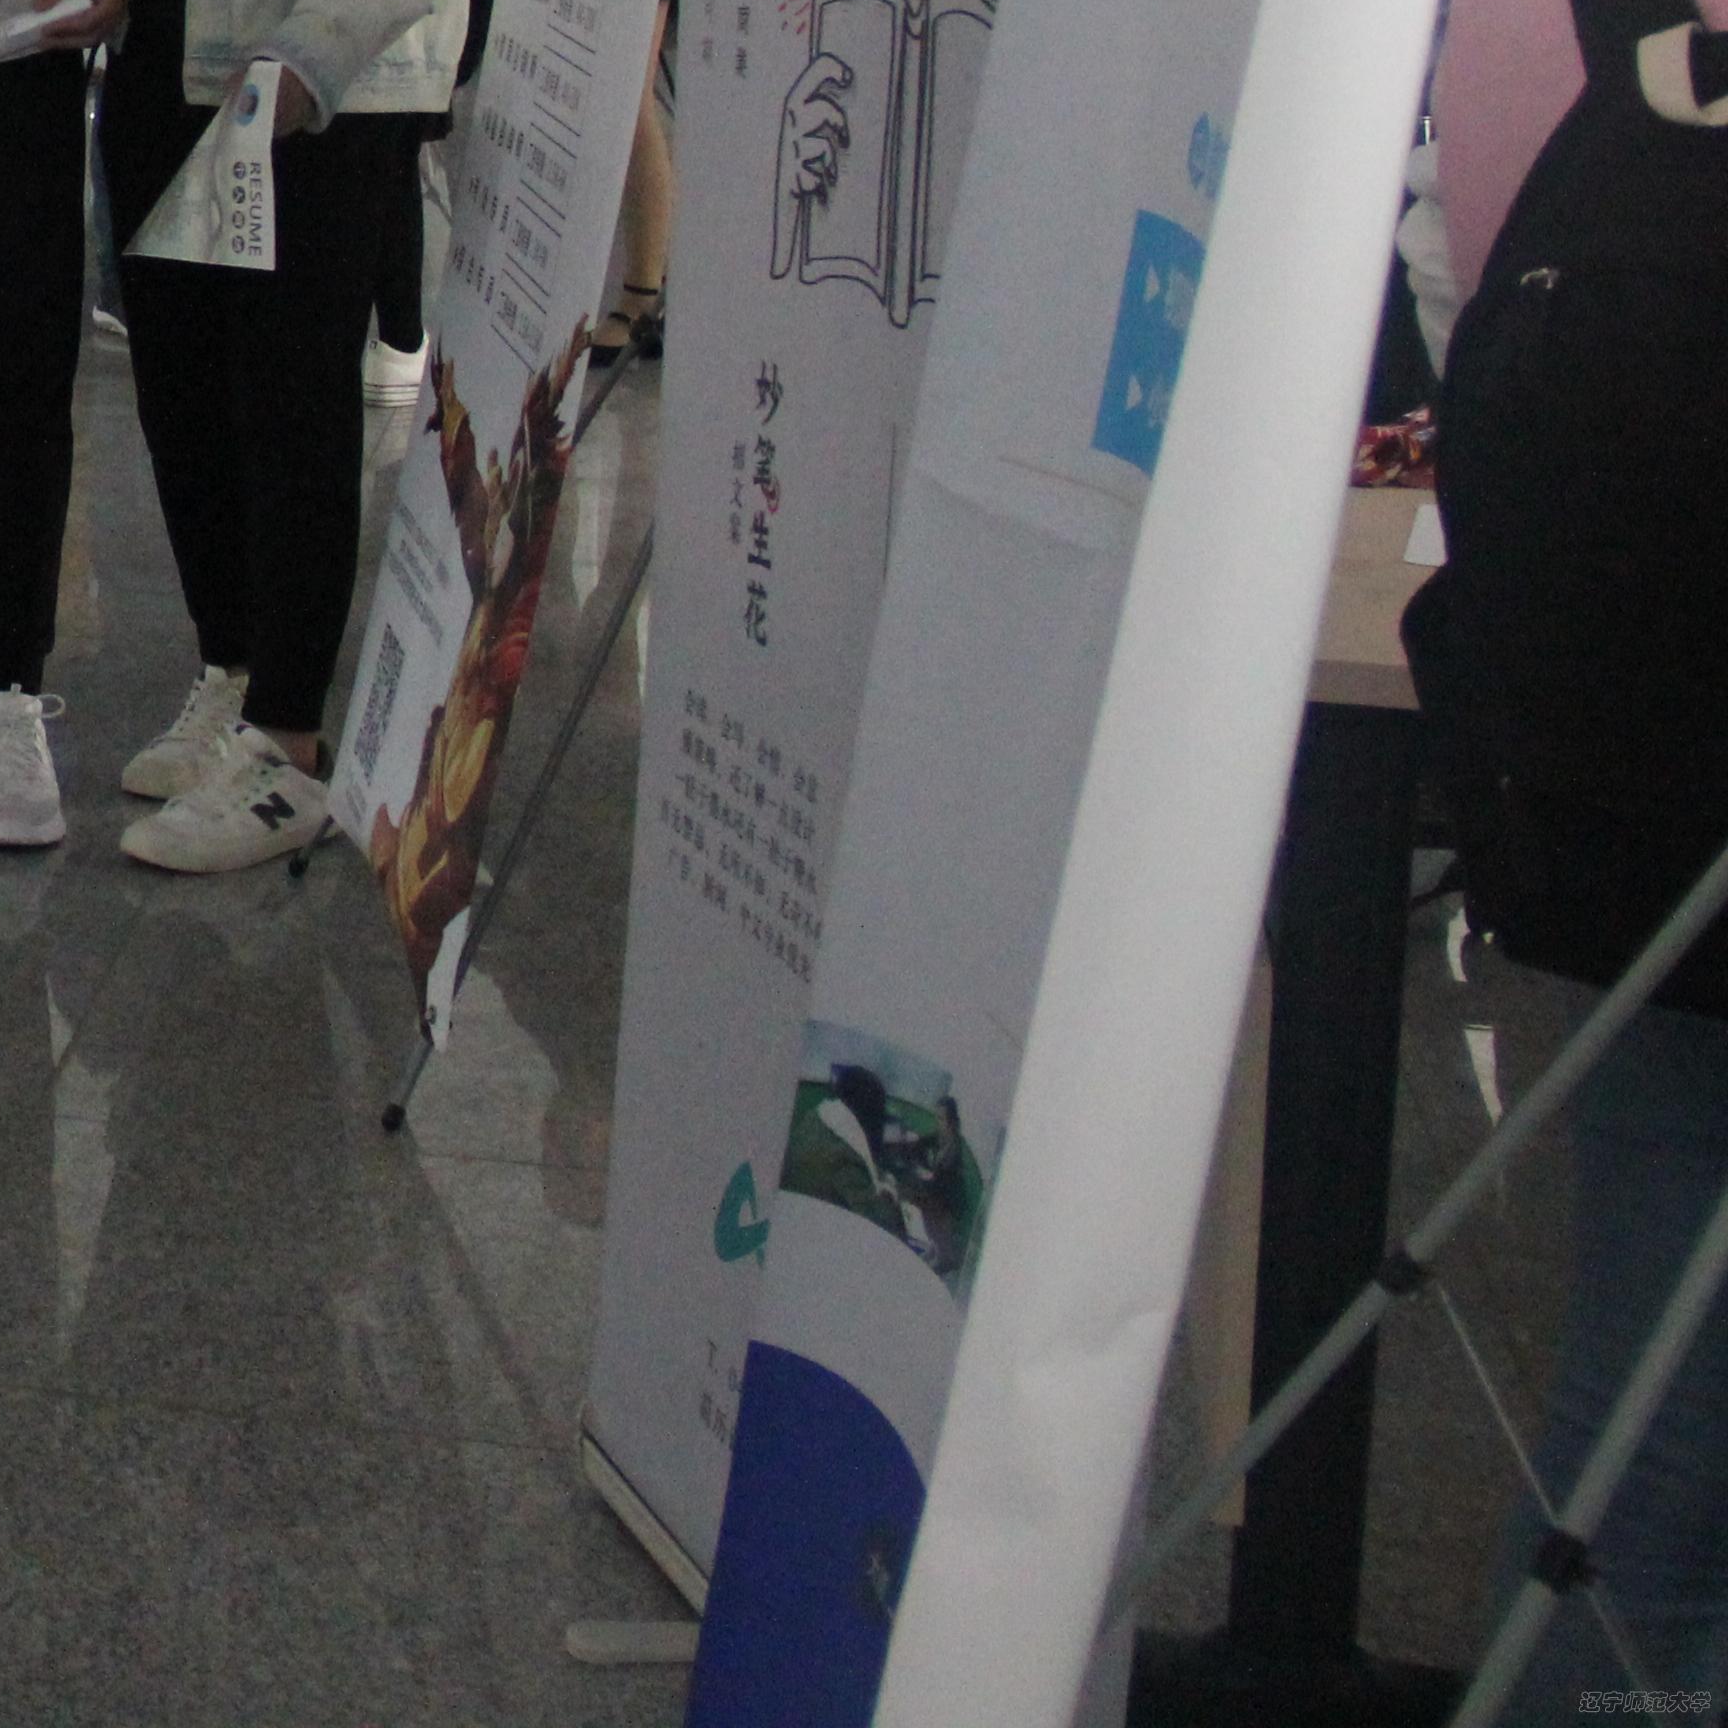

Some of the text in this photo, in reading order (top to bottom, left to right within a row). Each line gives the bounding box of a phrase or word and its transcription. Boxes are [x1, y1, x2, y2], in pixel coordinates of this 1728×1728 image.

[248, 161, 263, 257] RESUME
[746, 358, 784, 648] 妙笔生花
